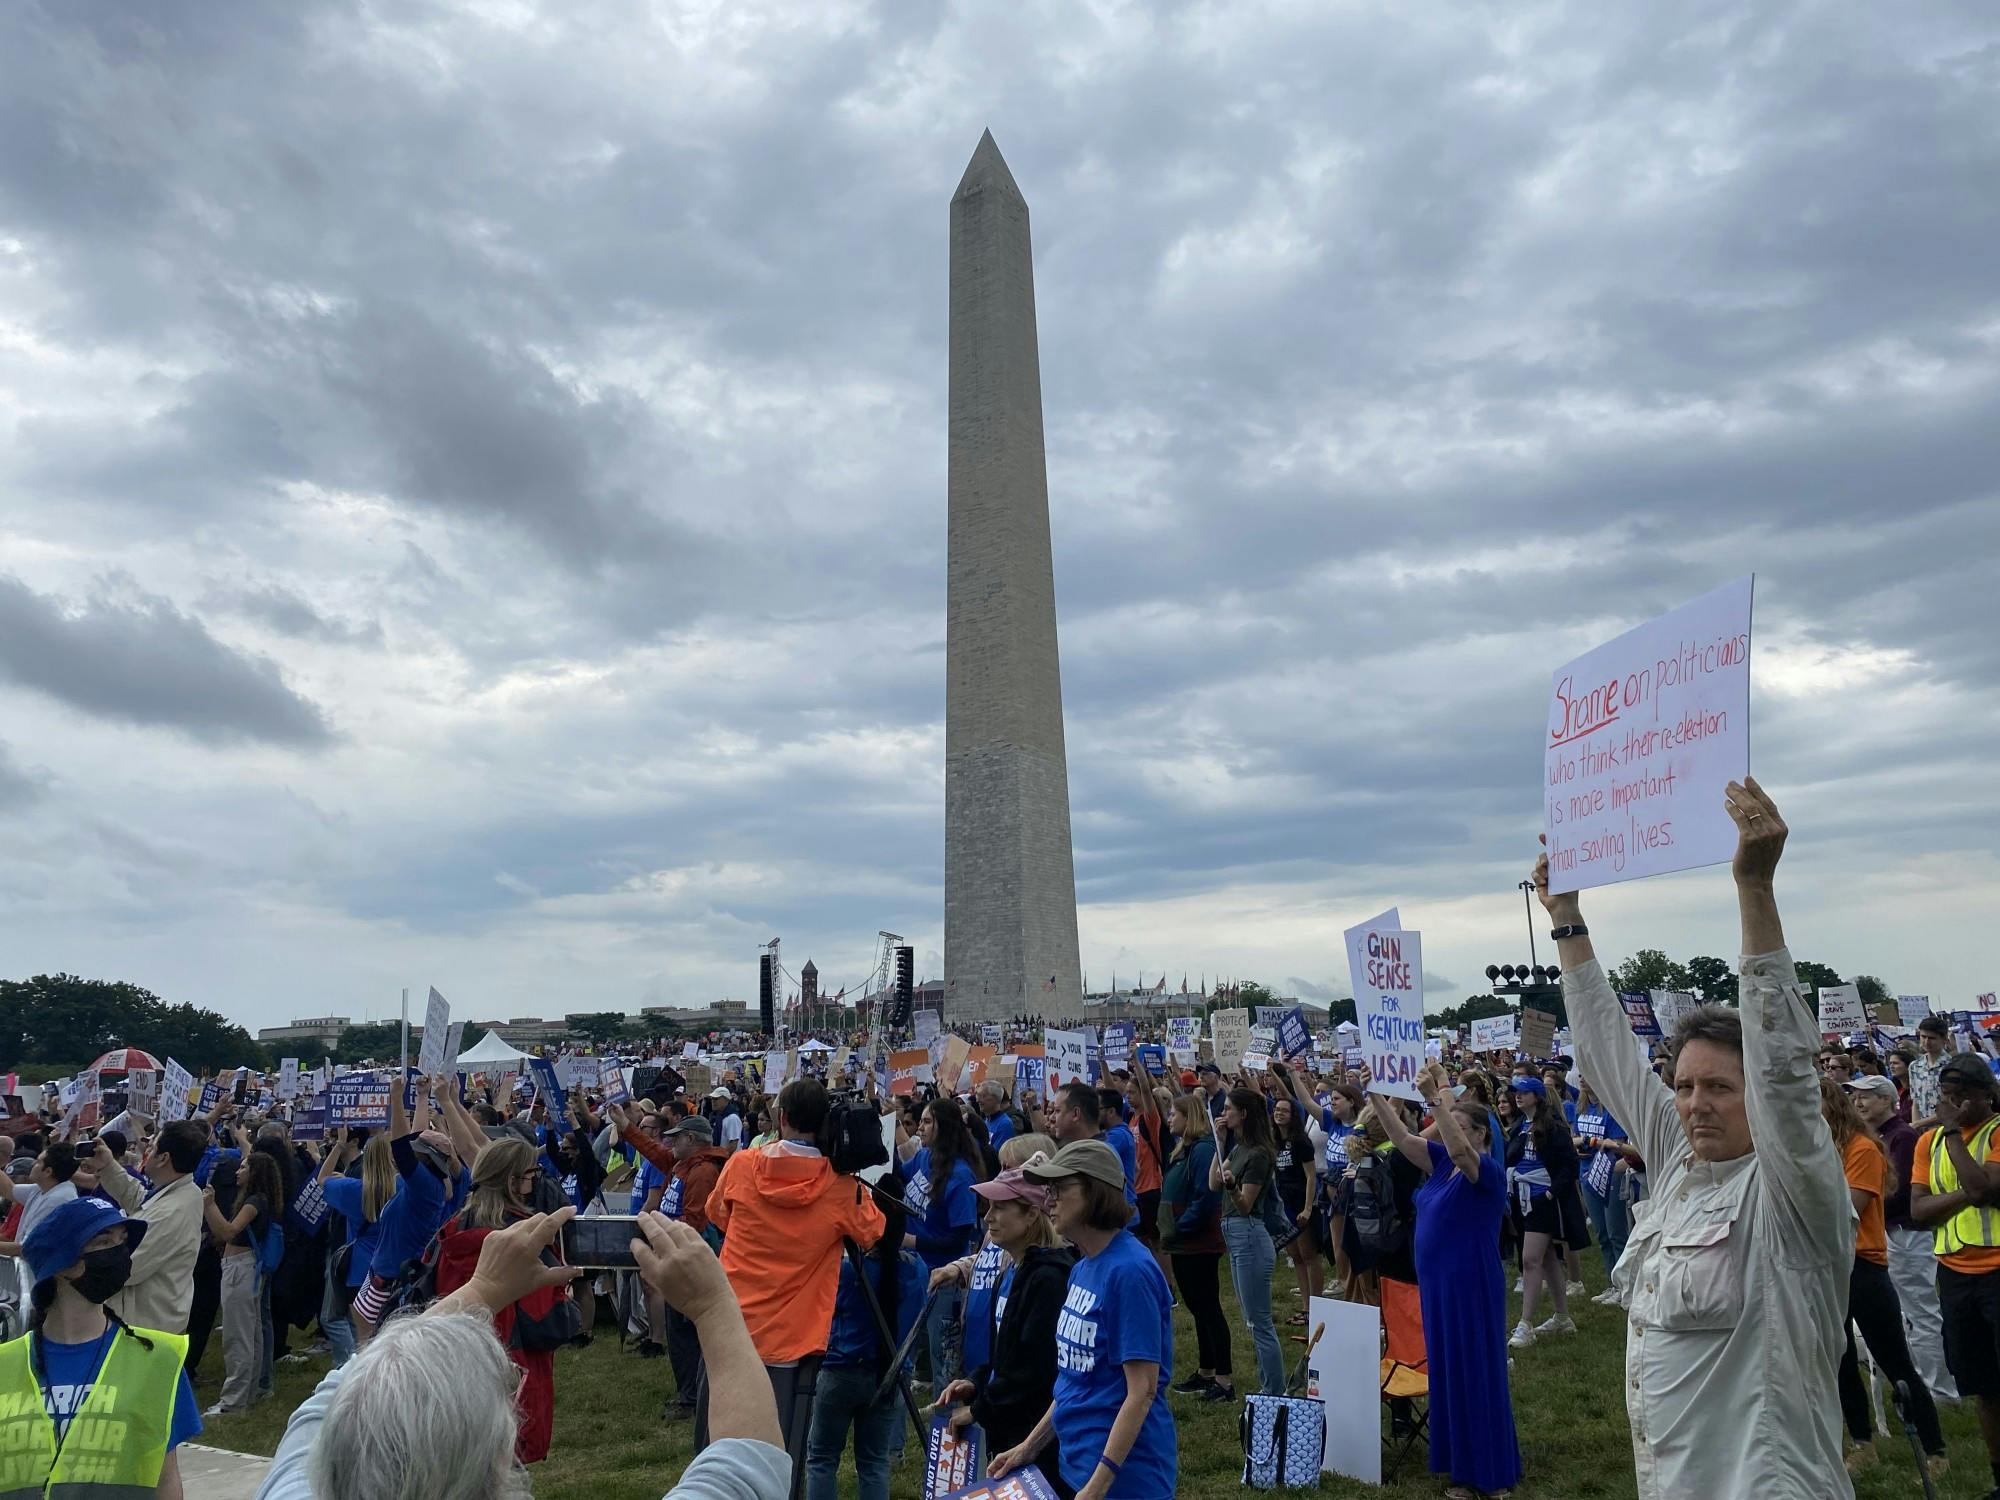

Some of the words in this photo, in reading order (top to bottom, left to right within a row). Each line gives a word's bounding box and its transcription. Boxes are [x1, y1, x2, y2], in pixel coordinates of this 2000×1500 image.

[1552, 675, 1619, 739] Shame
[1624, 669, 1650, 707] on
[1656, 634, 1748, 721] politicians
[1549, 754, 1575, 786] who
[1580, 740, 1621, 778] think
[1622, 728, 1660, 762] their
[1660, 709, 1727, 750] re-election
[1550, 800, 1563, 828] is
[1570, 789, 1604, 822] more
[1612, 764, 1676, 816] important
[1550, 838, 1578, 872] than
[1580, 828, 1625, 872] saving
[1631, 815, 1675, 857] lives.
[1367, 932, 1401, 963] GUN
[1367, 959, 1413, 991] SENSE
[1381, 995, 1402, 1012] FOR
[1824, 1006, 1845, 1014] BRAVE
[1172, 1018, 1190, 1027] MAKE
[1216, 1015, 1247, 1027] PROTECT
[1367, 1014, 1424, 1042] KENTUCKY
[1827, 1020, 1860, 1030] COWARDS
[1167, 1026, 1195, 1037] AMERICA
[1175, 1035, 1189, 1043] SAFE
[1217, 1030, 1242, 1040] PEOPLE
[1047, 1038, 1057, 1050] OUR
[1066, 1041, 1082, 1055] YOUR
[1172, 1042, 1191, 1050] AGAIN
[1221, 1049, 1239, 1057] GUNS
[1045, 1055, 1062, 1070] FUTURE
[1067, 1061, 1082, 1074] GUNS
[1372, 1054, 1417, 1092] USA!
[329, 1093, 357, 1106] TEXT
[358, 1093, 390, 1106] NEXT
[332, 1107, 342, 1118] to
[343, 1107, 387, 1118] 954-954
[1577, 1114, 1603, 1125] MARCH
[293, 1177, 318, 1212] MARCH
[929, 1427, 941, 1464] OVER
[926, 1461, 936, 1490] NOT
